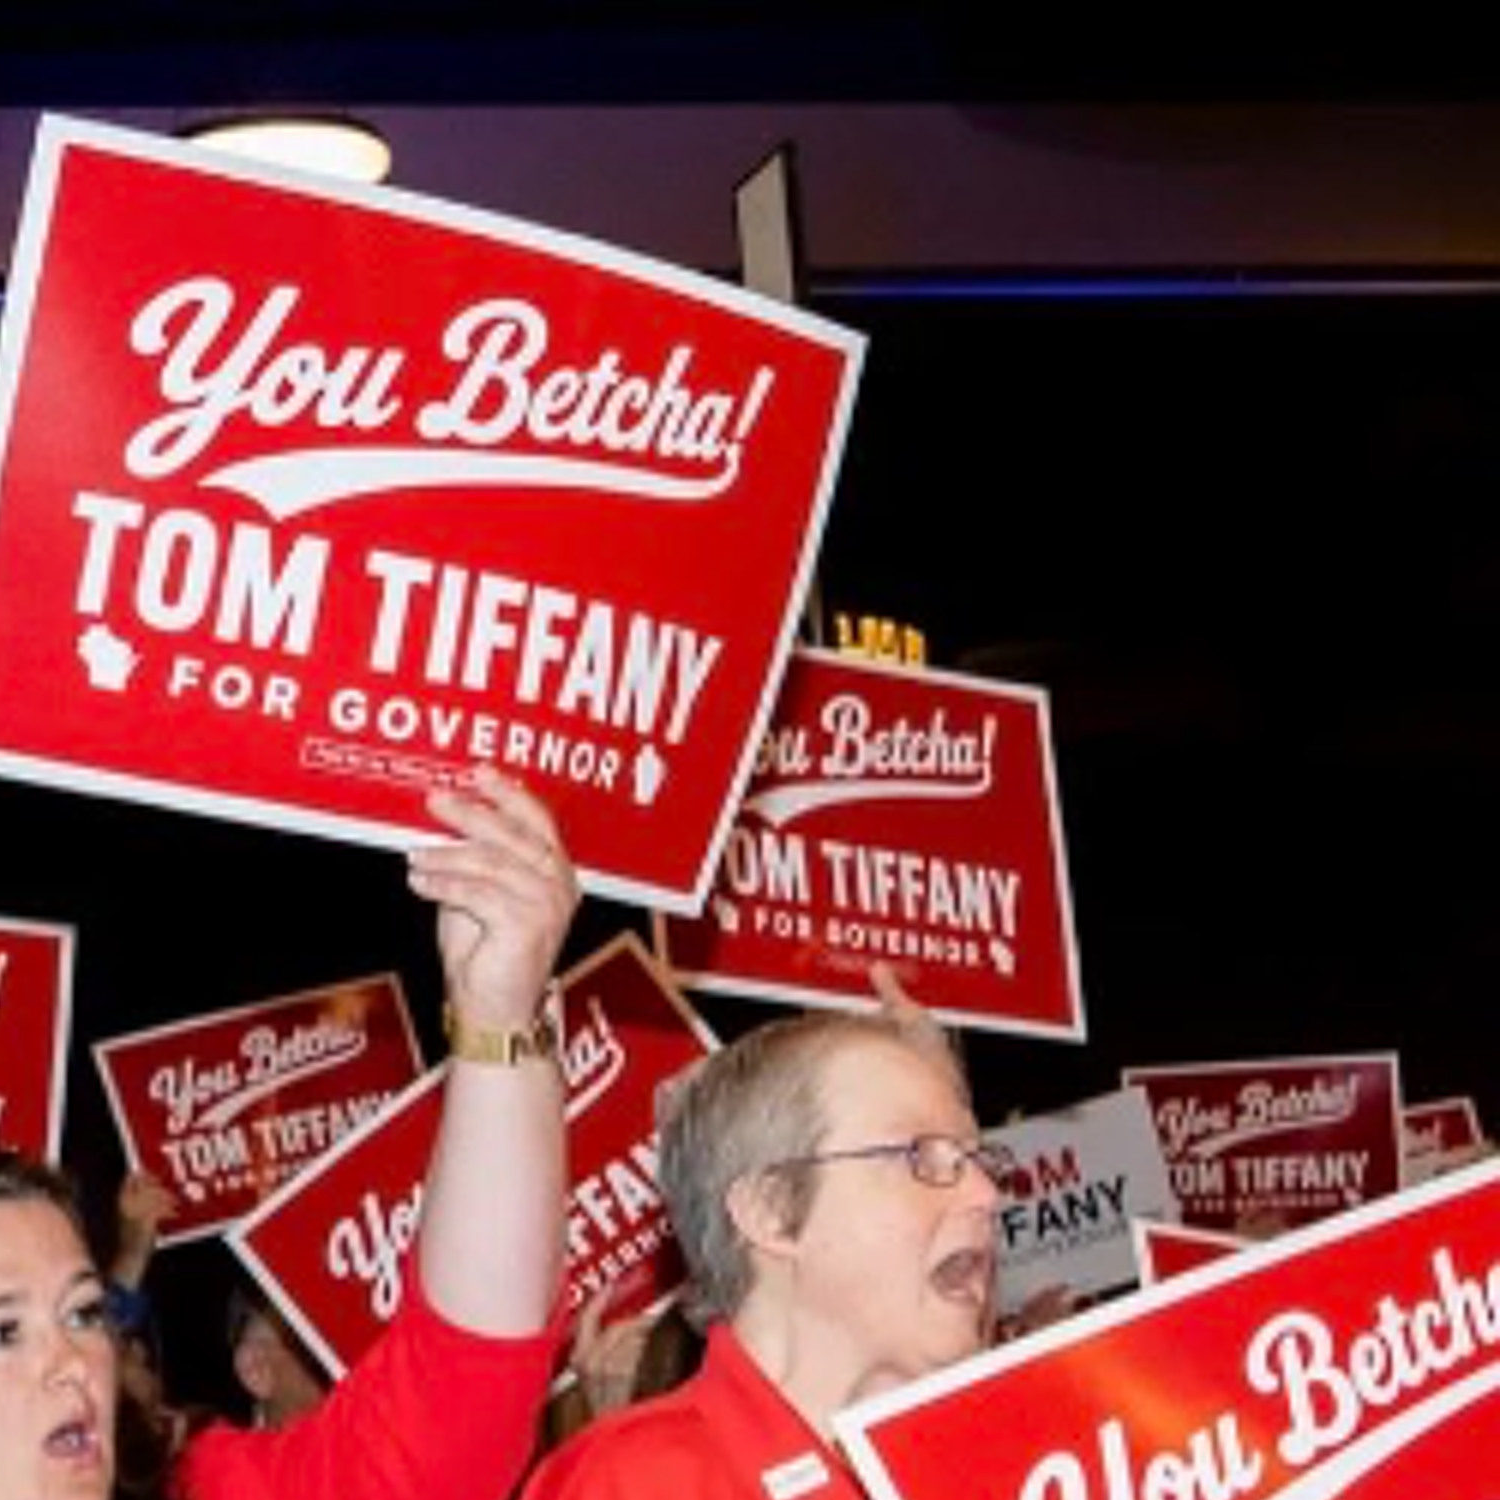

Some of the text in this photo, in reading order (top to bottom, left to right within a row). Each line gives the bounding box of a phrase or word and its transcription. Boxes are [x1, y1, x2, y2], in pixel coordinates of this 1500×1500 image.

[124, 276, 774, 477] You Betcha!
[72, 490, 724, 745] TOM TIFFANY
[167, 657, 300, 724] FOR
[330, 688, 621, 794] GOVERNOR
[754, 694, 998, 777] ou Betcha!
[726, 826, 1020, 937] OM TIFFANY
[755, 909, 811, 939] FOR
[149, 1058, 240, 1134] You
[162, 1126, 250, 1183] TOM
[1170, 1150, 1370, 1196] OM TIFFANY
[328, 1182, 424, 1322] Yo
[1001, 1173, 1127, 1248] FANY
